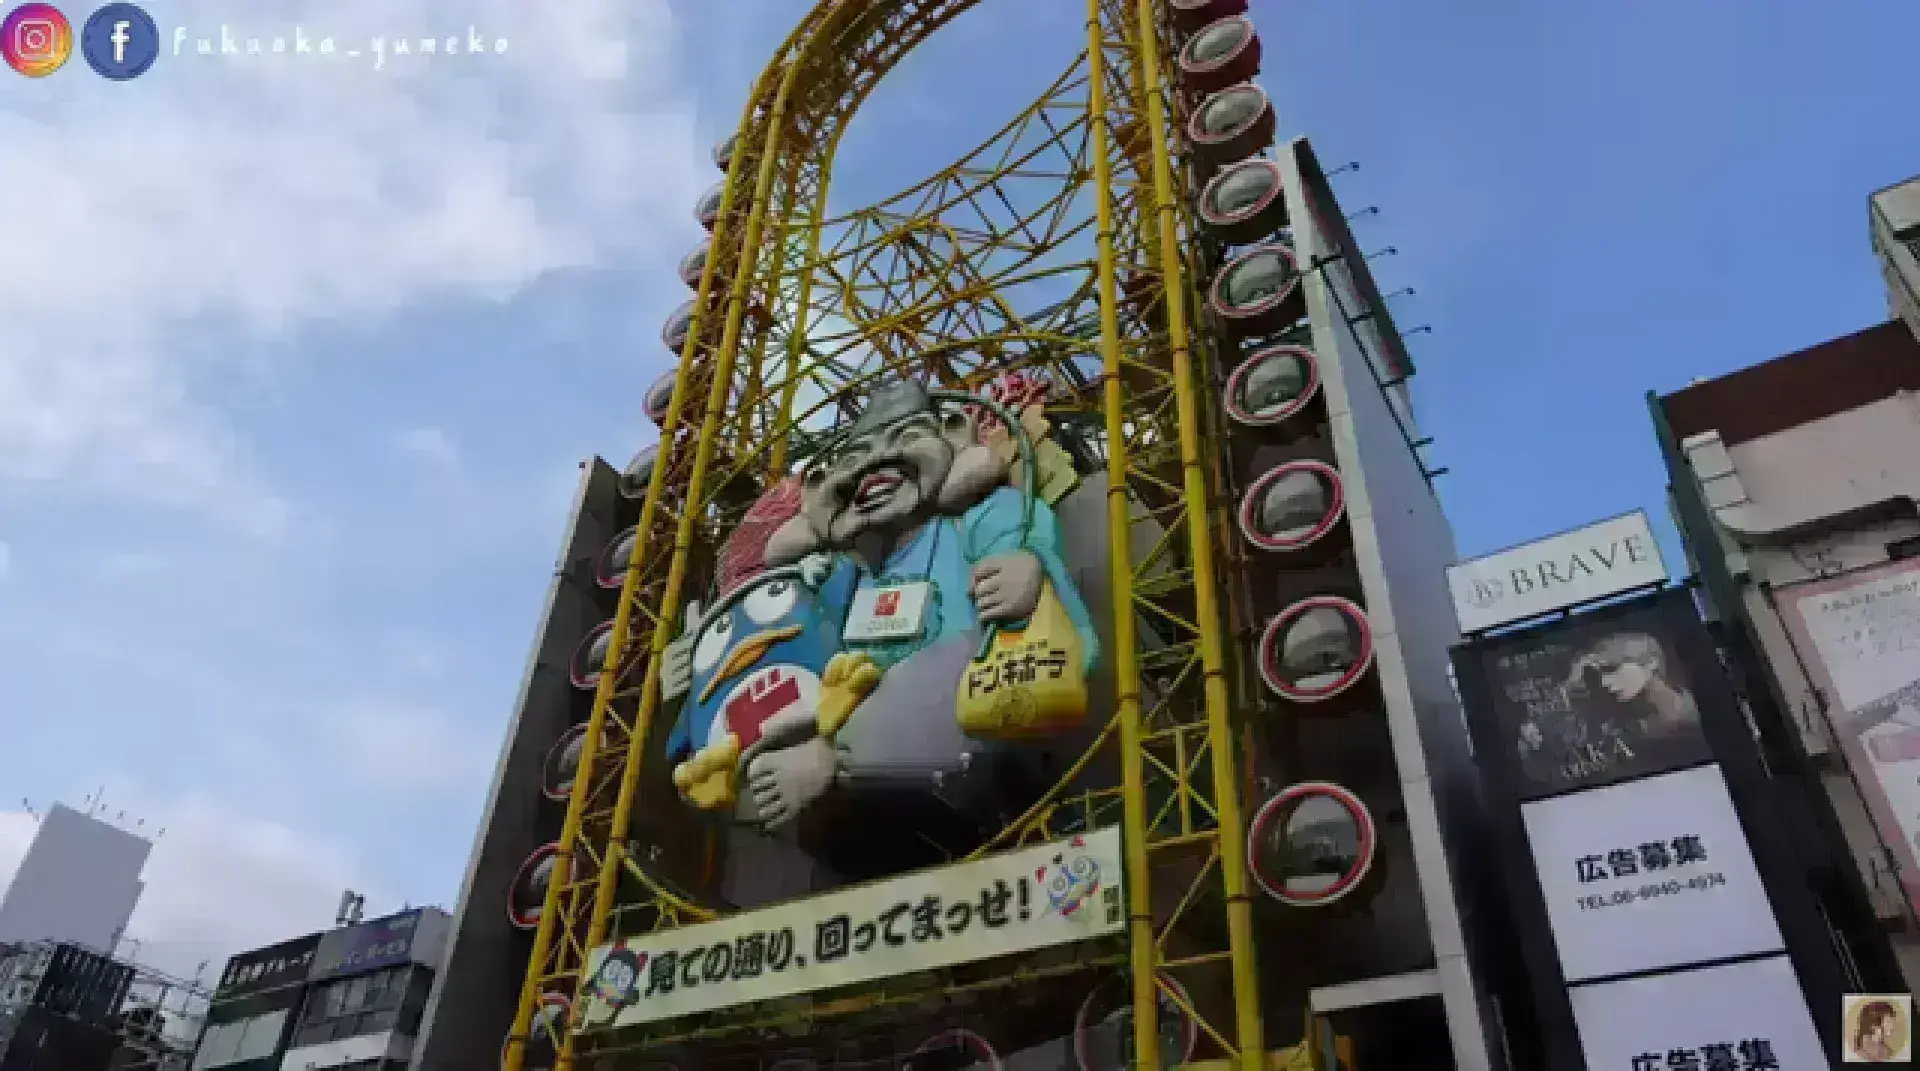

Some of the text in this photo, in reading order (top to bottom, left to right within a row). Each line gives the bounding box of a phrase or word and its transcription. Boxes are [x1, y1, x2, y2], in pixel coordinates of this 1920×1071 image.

[1508, 533, 1648, 595] BRAVE
[1574, 833, 1708, 883] 広告募集
